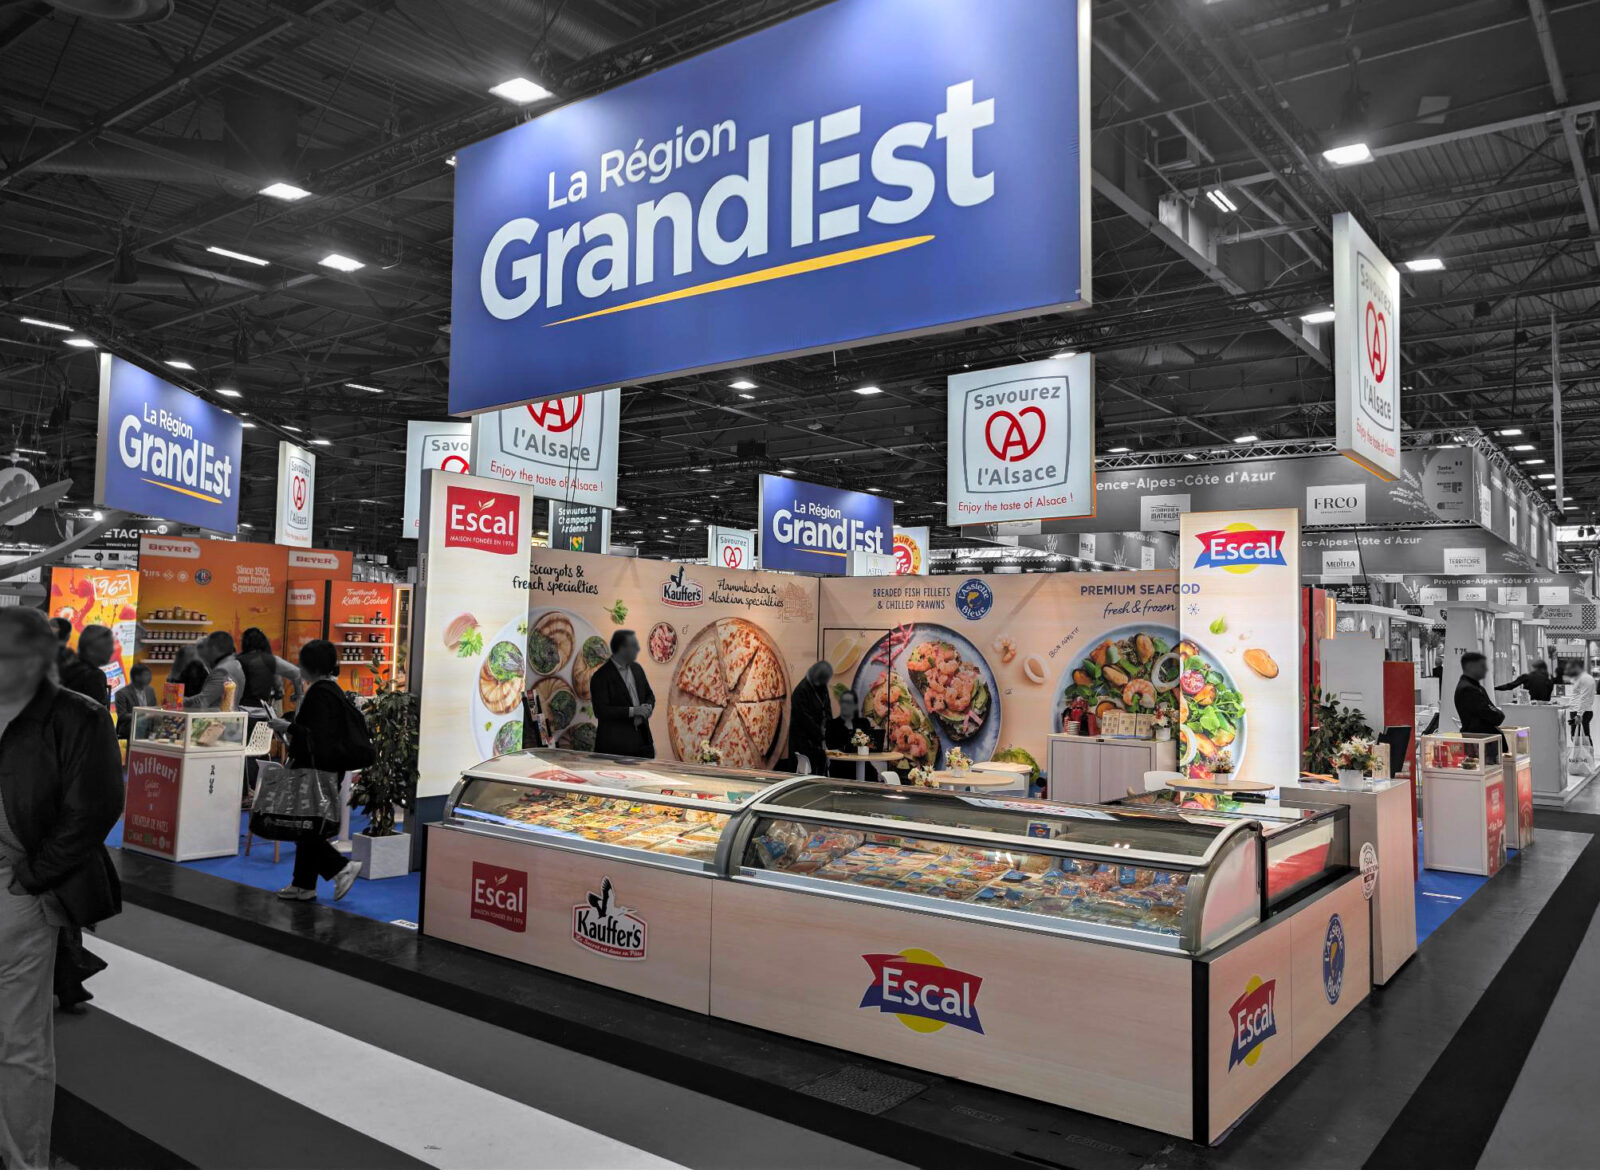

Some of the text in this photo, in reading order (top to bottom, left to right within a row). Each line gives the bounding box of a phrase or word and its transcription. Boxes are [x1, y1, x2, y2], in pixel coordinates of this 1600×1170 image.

[548, 118, 737, 210] La Région
[1360, 263, 1392, 316] Savourez
[973, 385, 1061, 410] Savourez
[1363, 375, 1392, 420] l'Alsace
[143, 402, 193, 440] La Région
[431, 439, 469, 452] Savo
[513, 427, 590, 461] l'Alsace
[490, 460, 516, 481] Enjoy
[519, 468, 533, 482] the
[536, 473, 556, 487] taste
[559, 477, 568, 488] of
[570, 479, 598, 491] Alsace
[977, 464, 1057, 487] l'Alsace
[1096, 470, 1276, 490] ence-Alpes-Côte d'Azur
[794, 500, 842, 520] La Région
[958, 501, 981, 514] Enjoy
[984, 500, 997, 511] the
[1000, 499, 1021, 511] taste
[1023, 497, 1034, 509] of
[1036, 494, 1067, 507] Alsace
[450, 503, 514, 536] Escal
[149, 543, 192, 553] BEYER
[449, 535, 472, 543] MAISON
[473, 536, 493, 545] FONDÉE
[719, 536, 747, 547] Savourez
[1209, 536, 1278, 560] Escal
[1301, 536, 1422, 549] ce-Alpes-Côte d'Azur
[236, 564, 254, 574] Since
[296, 555, 332, 565] BEYER
[576, 565, 584, 578] &
[98, 578, 128, 596] 96%
[238, 584, 275, 594] generations
[512, 575, 599, 596] french specialties
[663, 584, 702, 601] Kauffer's
[872, 586, 951, 598] BREADED FISH FILLETS
[1080, 584, 1136, 596] PREMIUM
[708, 591, 744, 605] Alsatian
[877, 600, 946, 610] & CHILLED PRAWNS
[961, 605, 987, 618] Bleue
[1103, 599, 1177, 619] fresh & frozen
[132, 757, 178, 783] Valfleuri
[474, 878, 523, 913] Escal
[577, 910, 642, 949] Kauffer's
[881, 966, 972, 1019] Escal
[1237, 990, 1273, 1050] Escal
